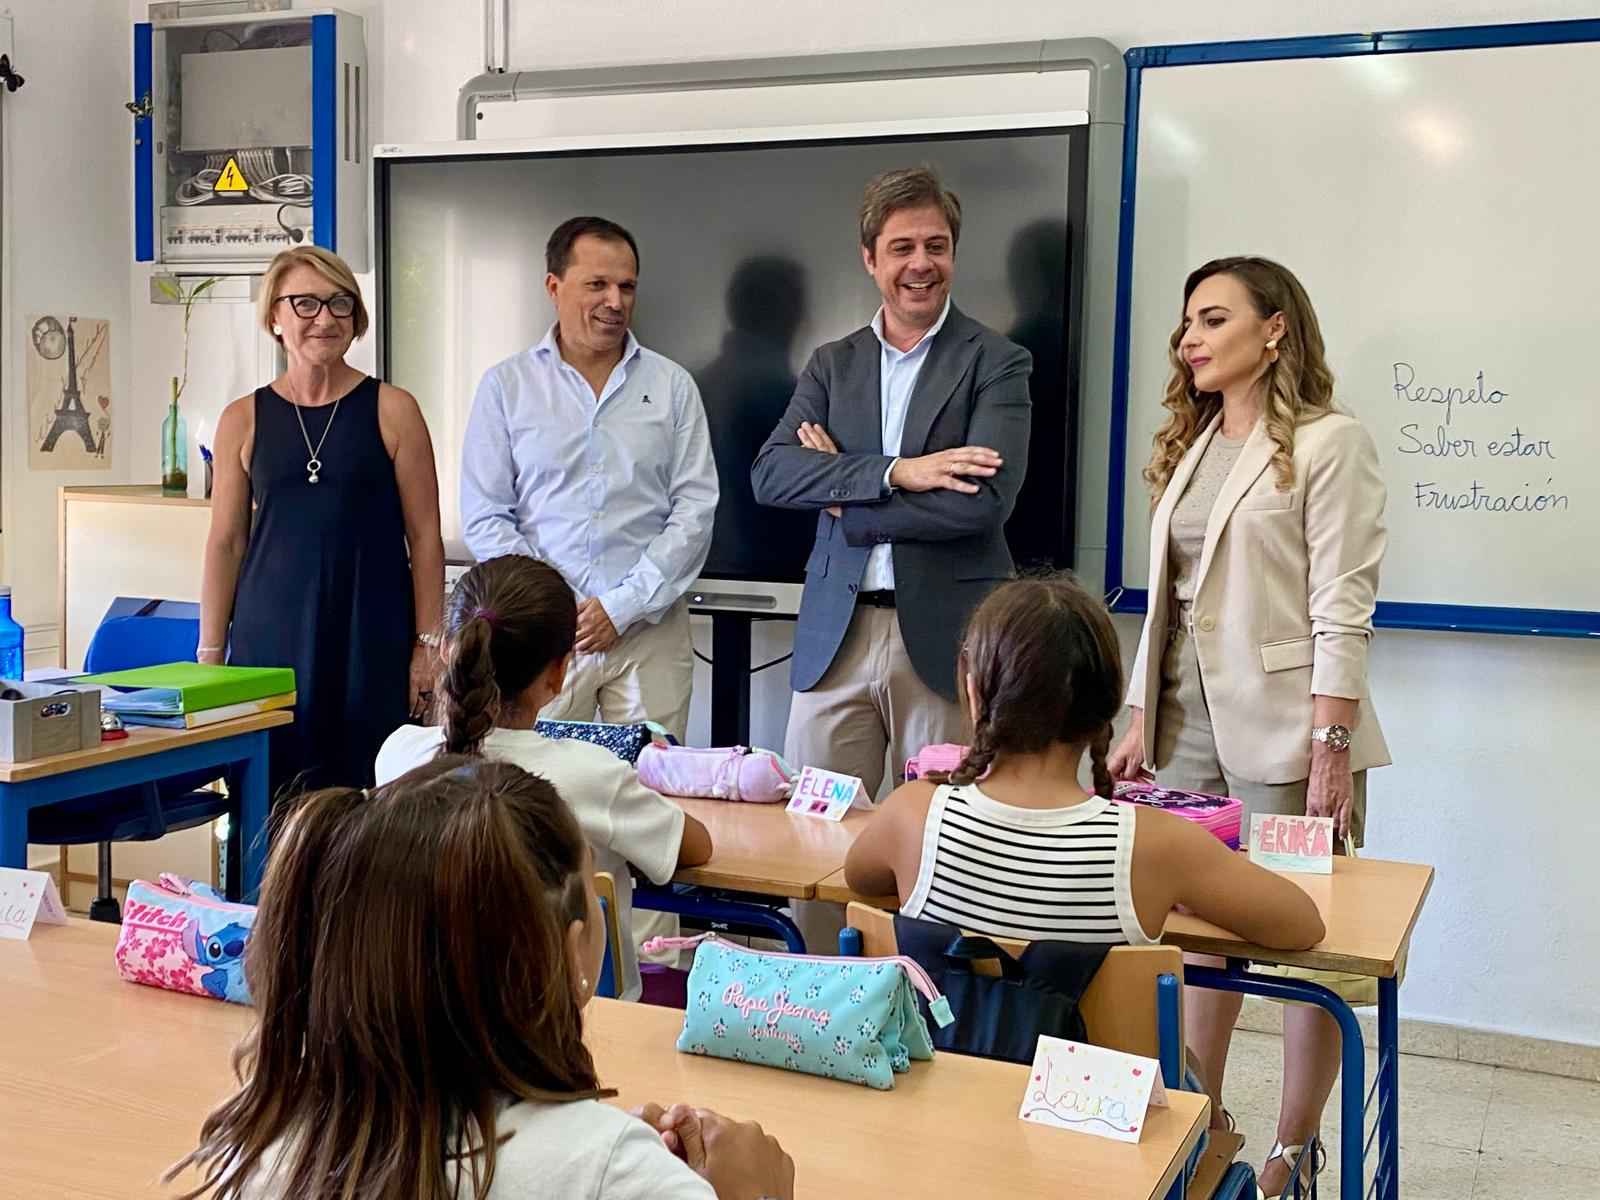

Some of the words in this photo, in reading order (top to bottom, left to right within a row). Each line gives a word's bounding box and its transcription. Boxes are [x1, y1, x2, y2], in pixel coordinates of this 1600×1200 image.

[1393, 362, 1509, 425] Respeto
[1398, 424, 1478, 457] Saber
[1488, 425, 1557, 459] estar
[1414, 477, 1568, 512] Frustración
[799, 777, 854, 803] ELENA
[722, 981, 768, 1018] Pepe
[766, 991, 832, 1025] Jeans
[1033, 1055, 1129, 1123] Laura
